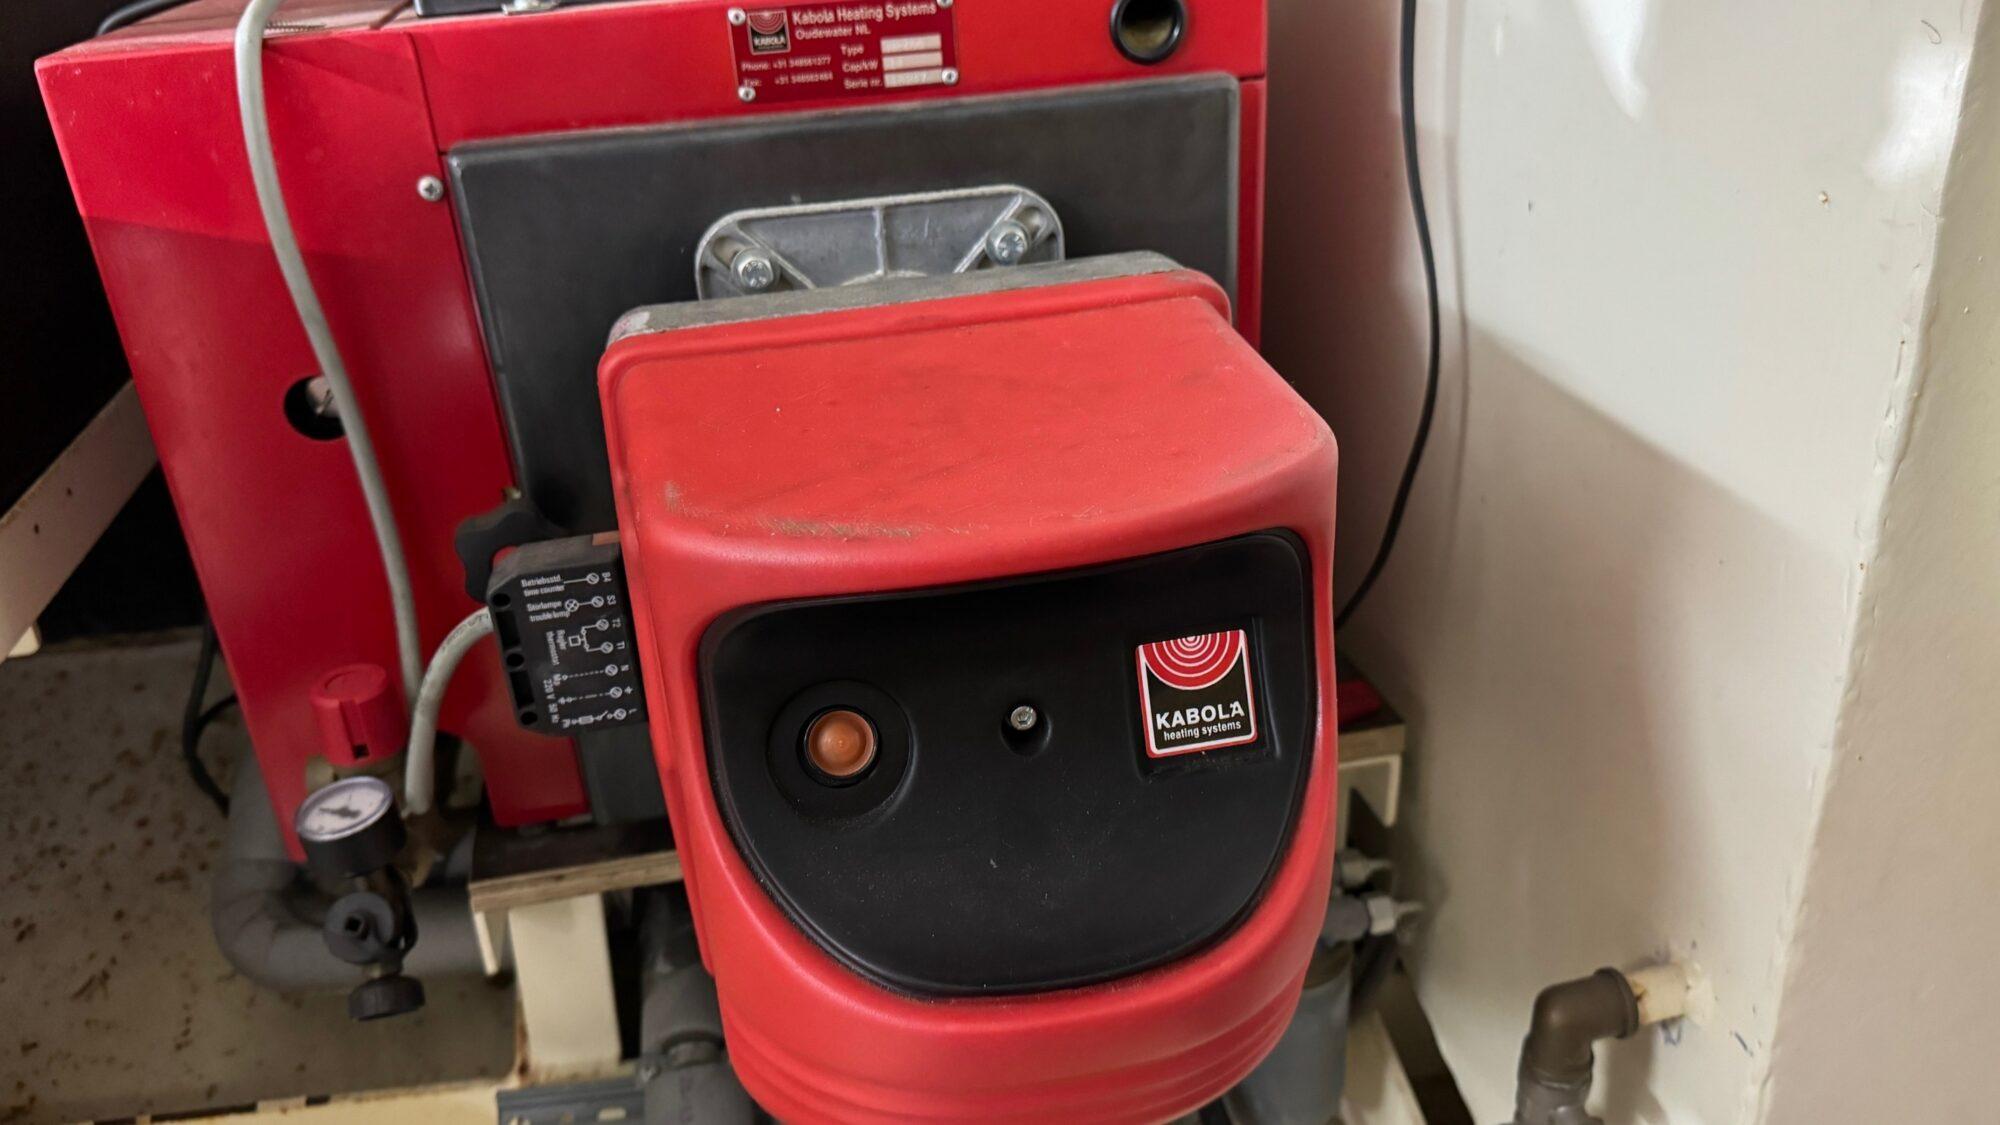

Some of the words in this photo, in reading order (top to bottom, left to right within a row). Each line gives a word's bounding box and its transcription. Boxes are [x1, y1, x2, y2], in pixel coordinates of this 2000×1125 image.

[793, 10, 835, 26] Kabola
[838, 7, 883, 23] Heating
[886, 3, 937, 19] Systems
[795, 26, 853, 40] Oudewater
[855, 24, 871, 36] NL
[840, 45, 864, 56] Type
[843, 61, 878, 73] Cap/kW
[845, 80, 868, 90] Serie
[524, 589, 539, 598] time
[541, 586, 565, 596] counter
[543, 679, 553, 693] 220
[1156, 701, 1245, 731] KABOLA
[1164, 728, 1200, 741] heating
[1202, 720, 1241, 736] systems
